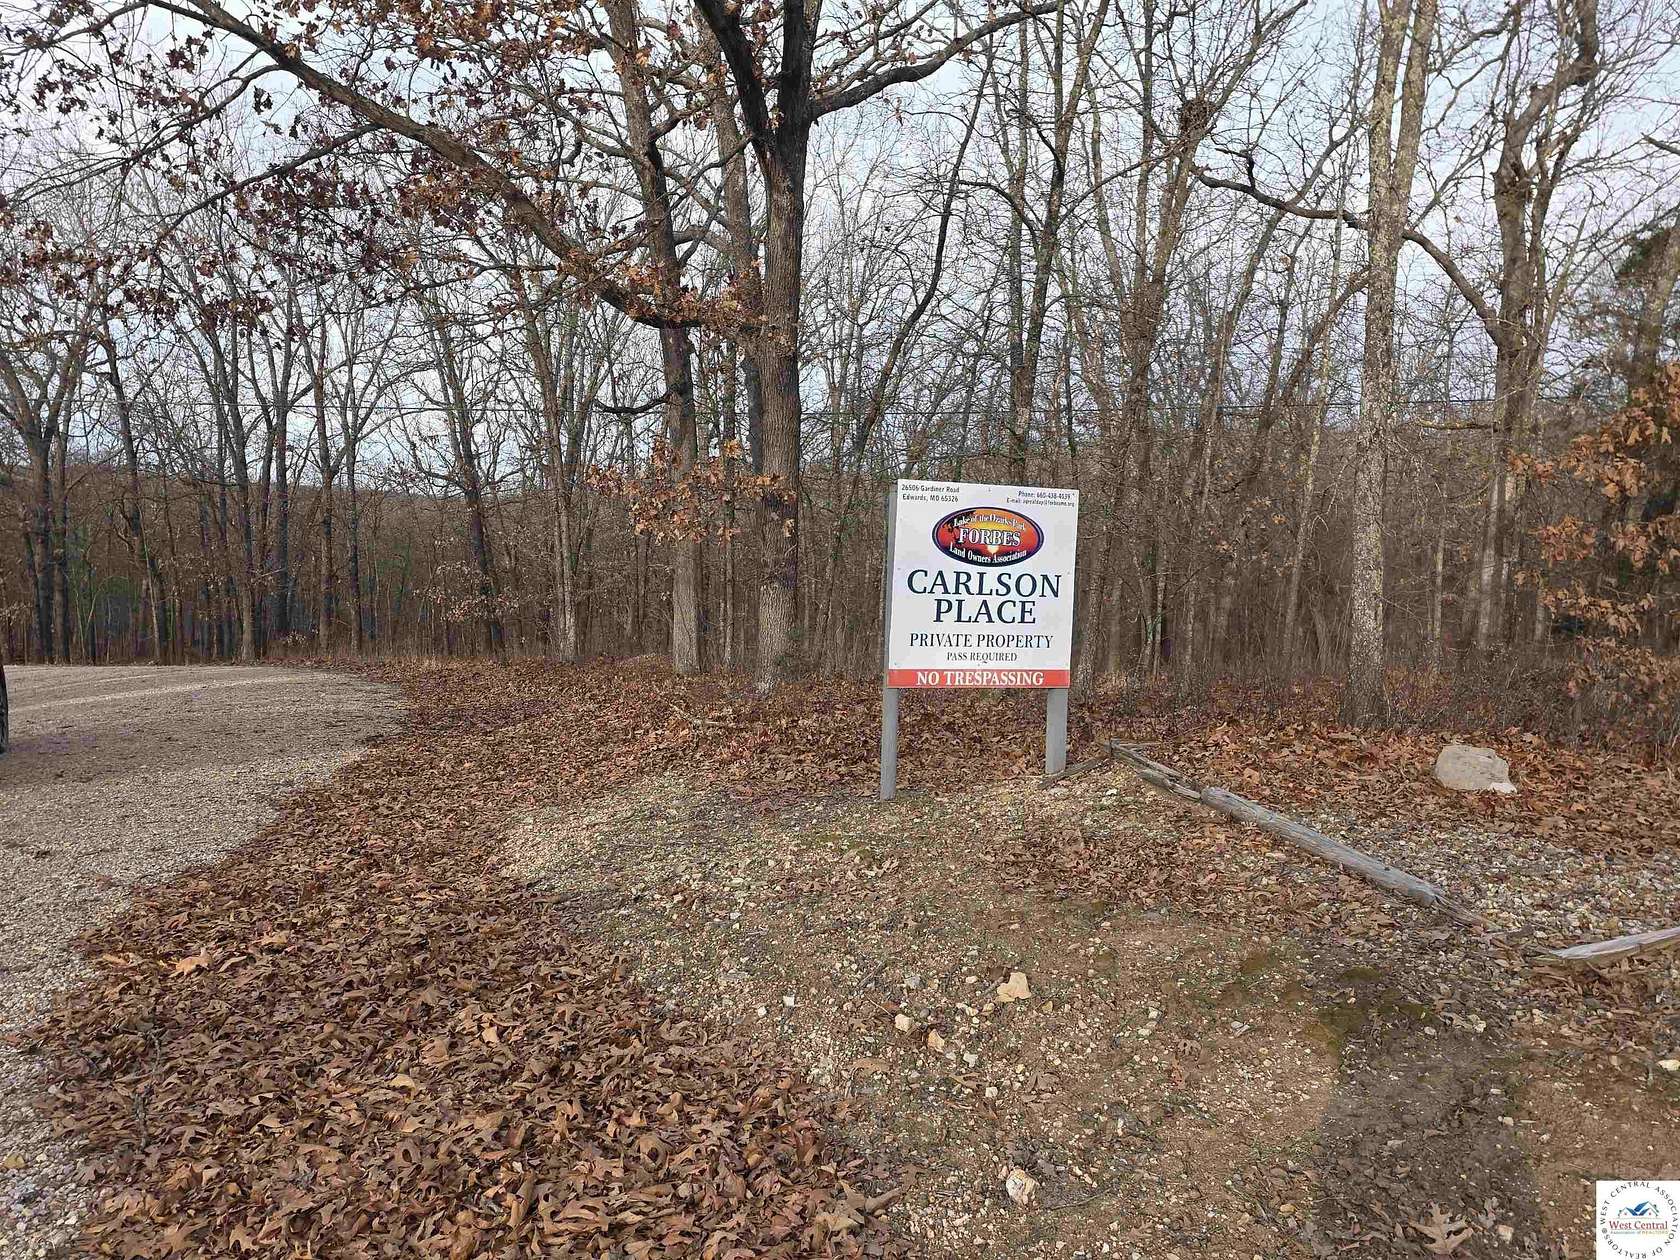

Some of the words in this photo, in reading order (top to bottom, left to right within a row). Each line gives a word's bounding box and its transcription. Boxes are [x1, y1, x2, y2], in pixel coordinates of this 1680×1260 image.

[1018, 490, 1036, 498] Phone:
[953, 516, 970, 527] Lake
[979, 514, 989, 522] the
[990, 514, 1012, 525] Ozarks
[958, 528, 1021, 547] FORBES
[950, 542, 966, 558] Land
[968, 550, 991, 563] Owners
[992, 549, 1027, 564] Association
[907, 569, 1062, 598] CARLSON
[933, 598, 1036, 624] PLACE
[909, 633, 973, 647] PRIVATE
[976, 634, 1054, 649] PROPERTY
[947, 652, 968, 661] PASS
[970, 652, 1018, 663] REQUIRED
[916, 671, 940, 685] NO
[943, 671, 1045, 686] TRESPASSING
